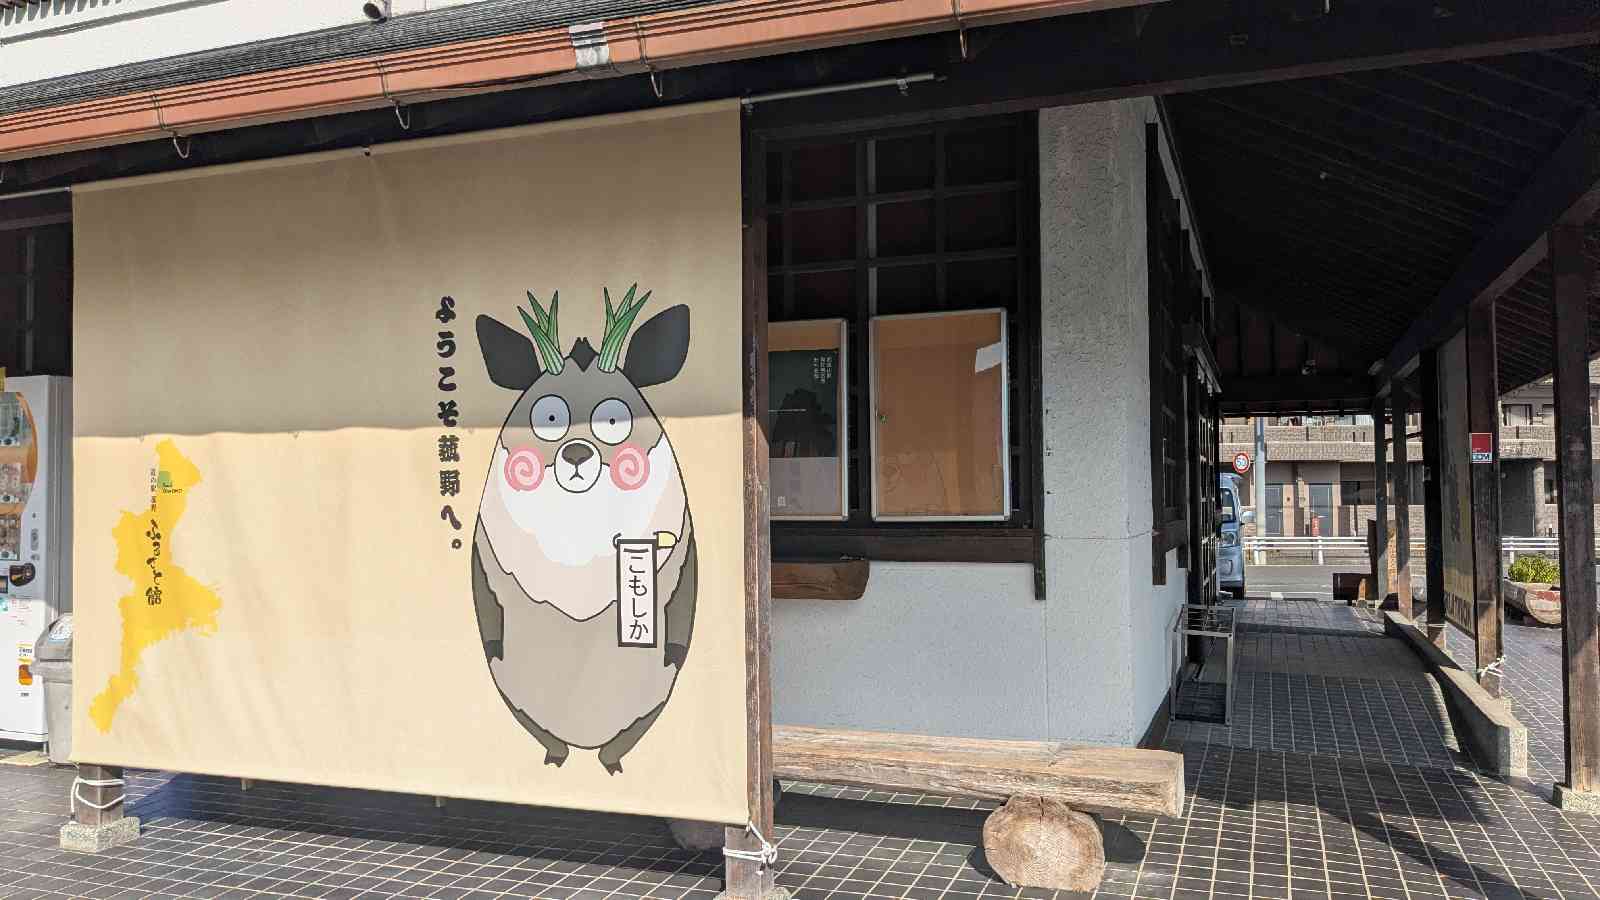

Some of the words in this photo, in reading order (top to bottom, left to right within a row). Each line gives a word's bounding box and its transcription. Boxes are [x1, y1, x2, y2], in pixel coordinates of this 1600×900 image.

[435, 295, 462, 550] ようこそ菰野へ。
[628, 556, 649, 640] こもしか
